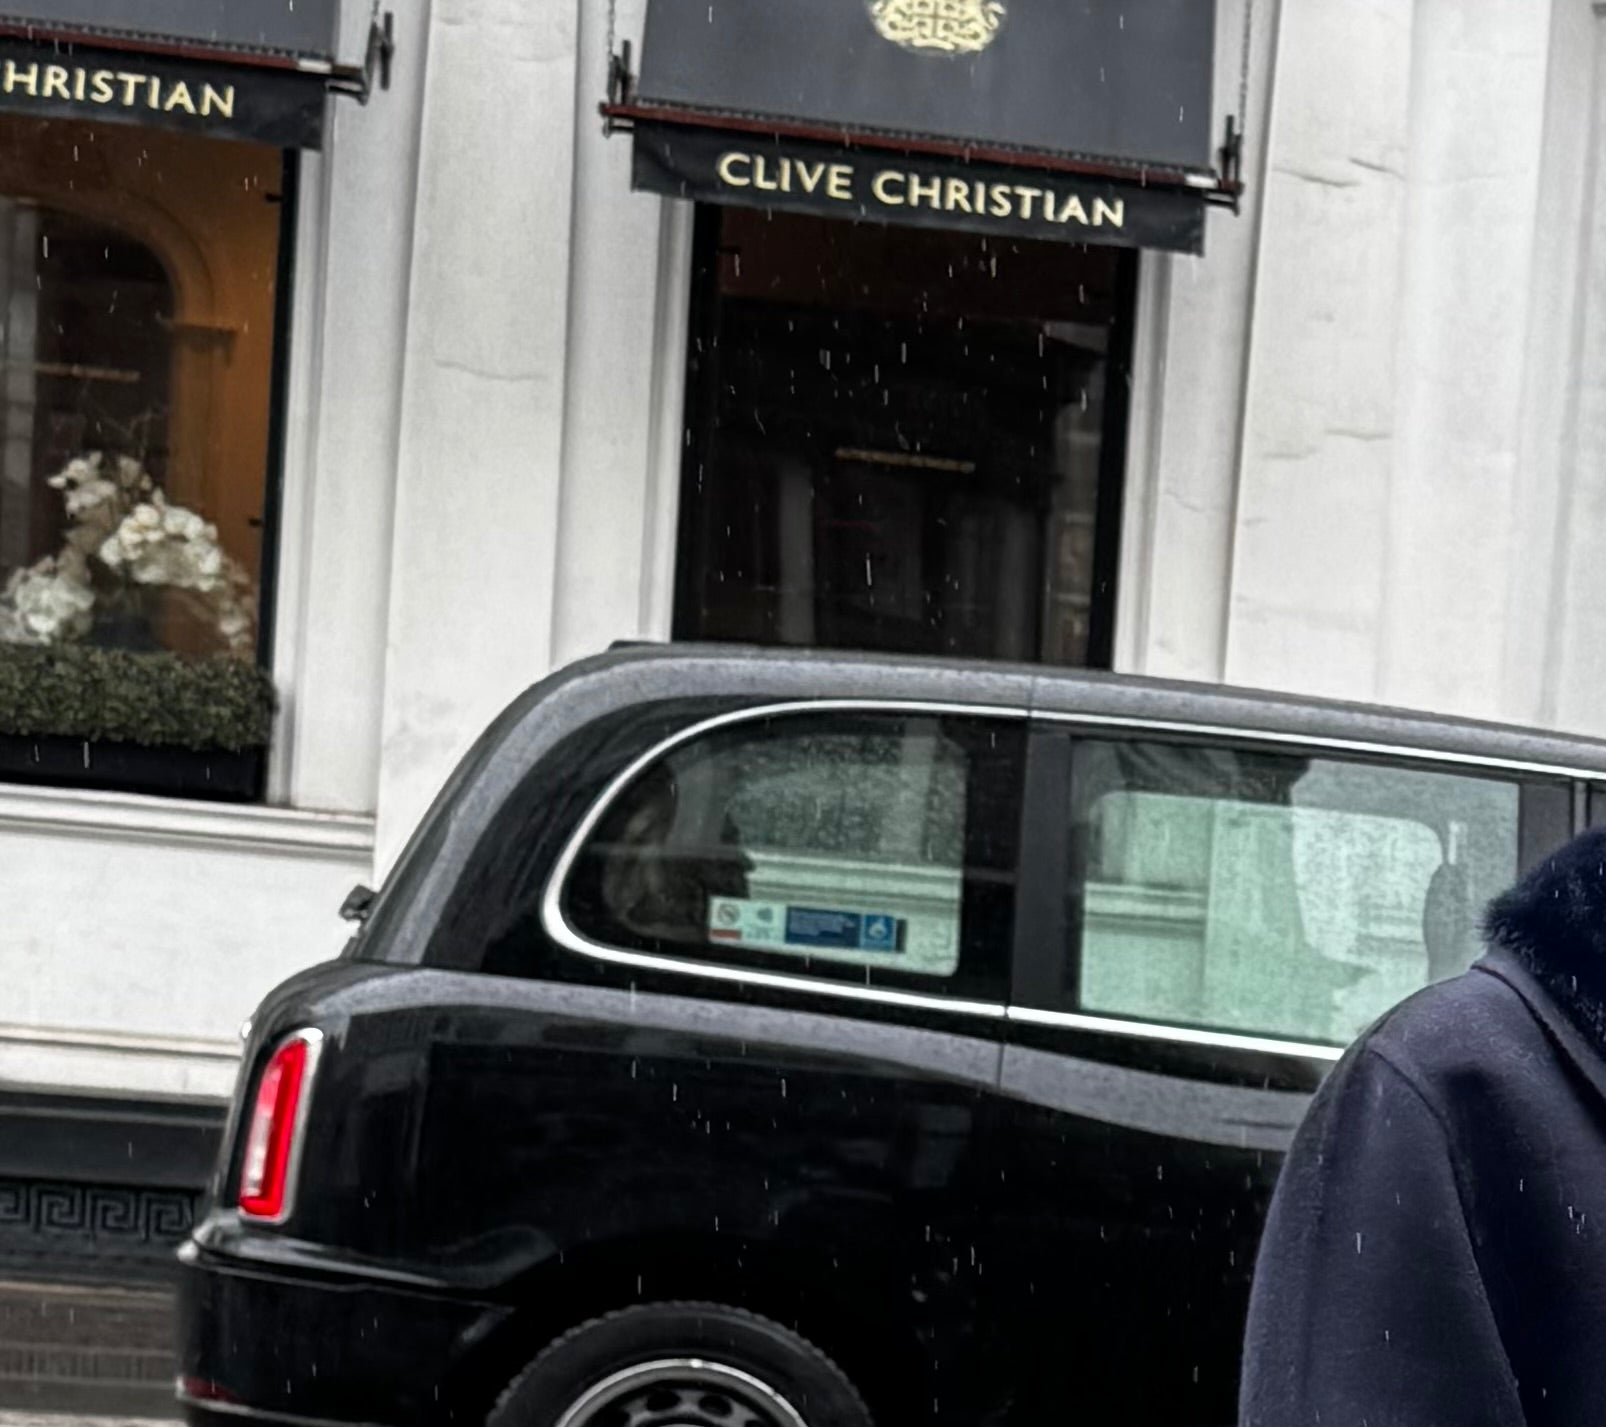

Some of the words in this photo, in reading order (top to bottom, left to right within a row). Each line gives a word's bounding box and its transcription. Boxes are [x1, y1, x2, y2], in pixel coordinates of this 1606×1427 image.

[0, 58, 235, 118] HRISTIAN
[716, 151, 855, 200] CLIVE
[871, 170, 1126, 228] CHRISTIAN
